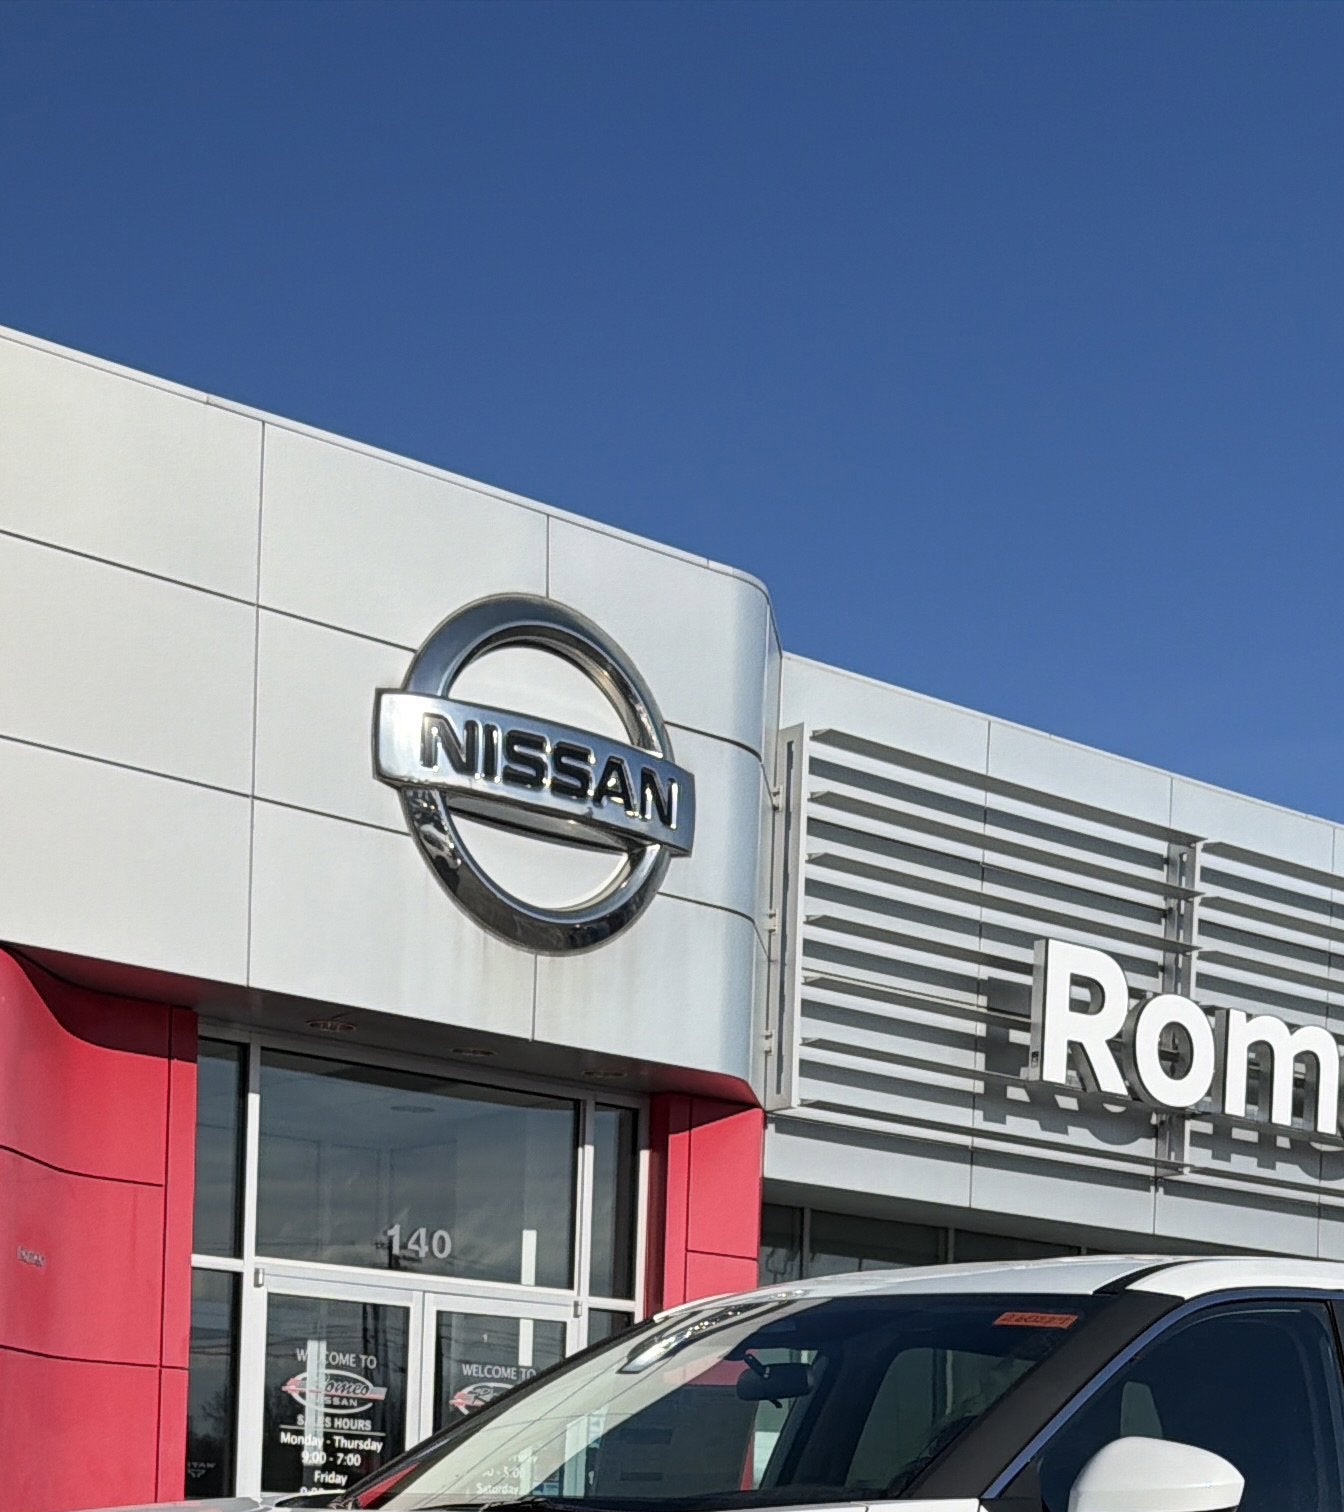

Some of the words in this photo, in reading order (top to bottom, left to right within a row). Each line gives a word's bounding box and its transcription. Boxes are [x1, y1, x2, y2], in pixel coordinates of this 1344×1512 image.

[419, 711, 679, 831] NISSAN
[387, 1223, 452, 1259] 140
[296, 1348, 357, 1367] WOME
[360, 1354, 377, 1369] TO
[462, 1363, 517, 1380] WELCOME
[297, 1414, 332, 1428] SES
[334, 1417, 372, 1431] HOURS
[280, 1431, 324, 1448] Monday
[333, 1435, 383, 1453] Thursday
[336, 1452, 361, 1466] 7:00
[314, 1469, 348, 1486] Friday
